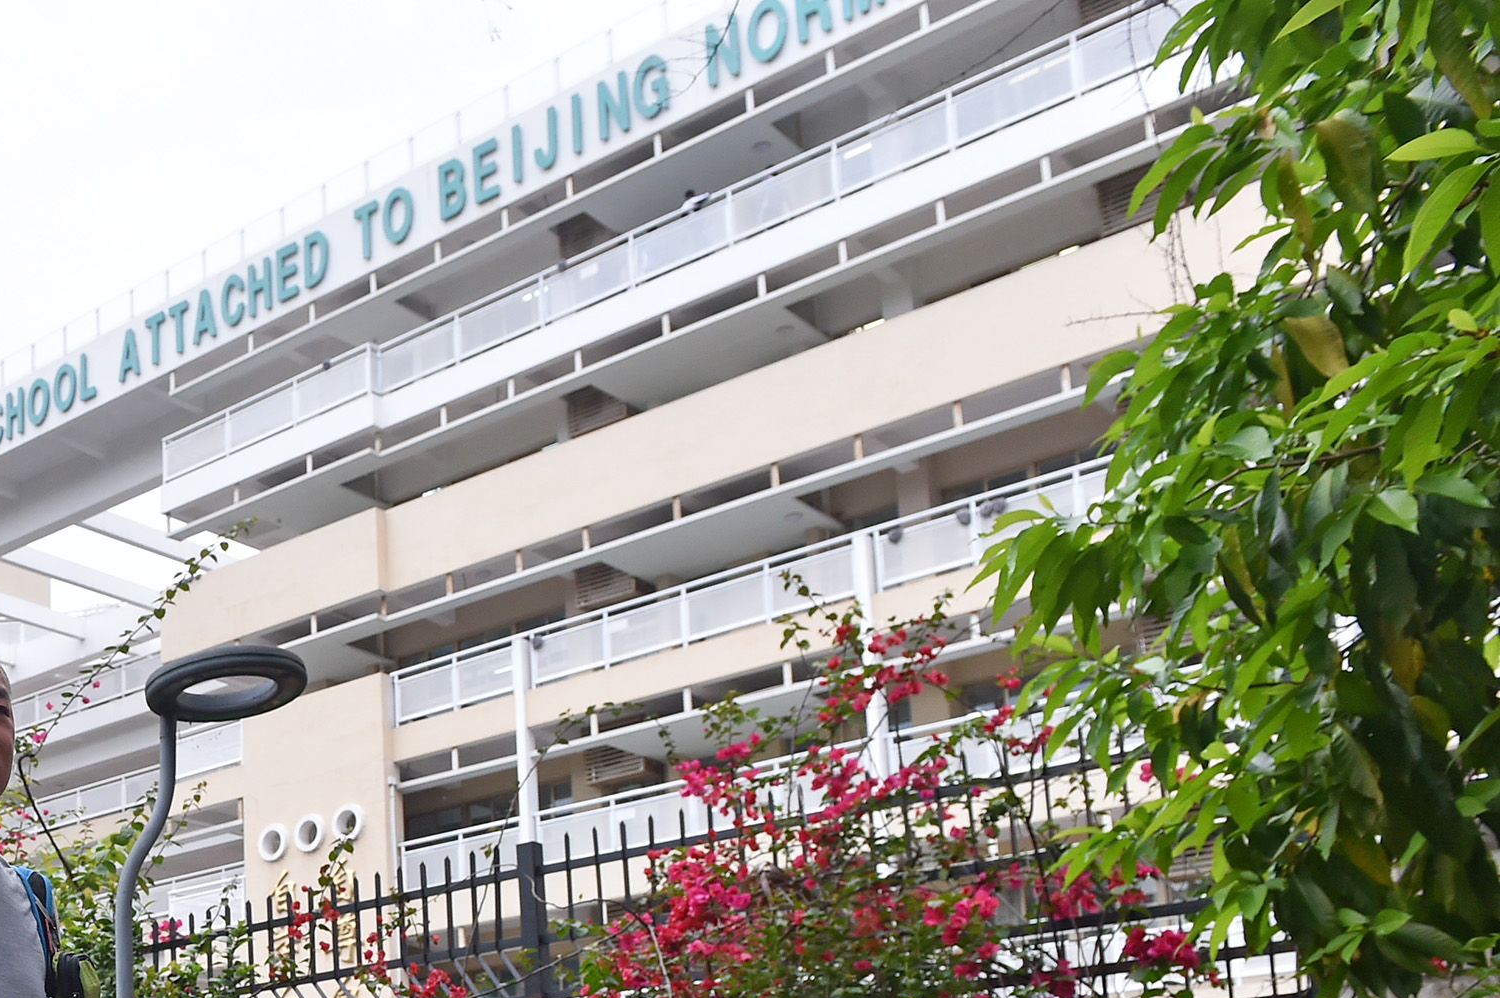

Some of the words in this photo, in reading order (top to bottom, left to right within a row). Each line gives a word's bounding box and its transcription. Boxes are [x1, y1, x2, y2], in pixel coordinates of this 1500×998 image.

[119, 229, 330, 383] ATTACHED
[354, 187, 414, 260] TO
[438, 55, 670, 222] BEIJING
